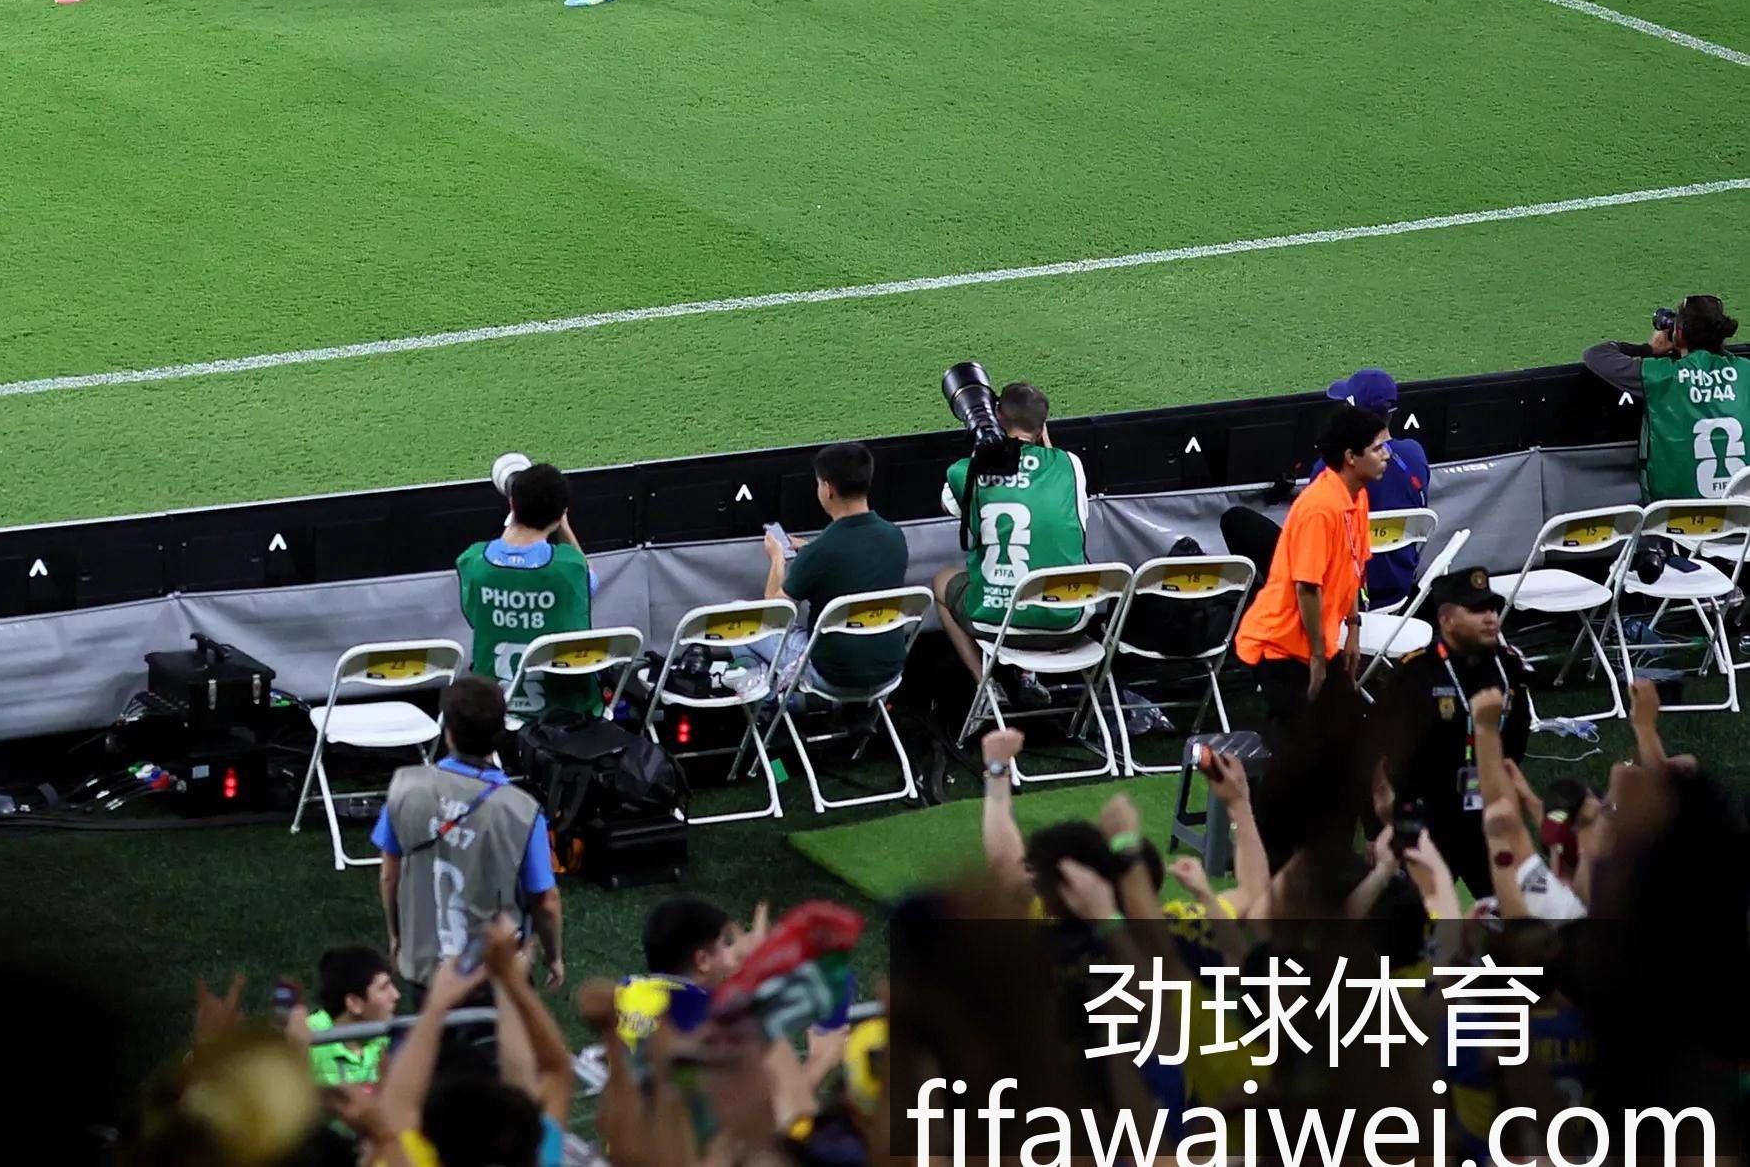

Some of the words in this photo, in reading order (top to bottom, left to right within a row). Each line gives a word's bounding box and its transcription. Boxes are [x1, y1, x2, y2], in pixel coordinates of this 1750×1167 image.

[1677, 366, 1739, 388] PHOTO
[1689, 384, 1737, 405] 0744
[1373, 527, 1386, 538] 16
[994, 567, 1015, 579] FIFA
[480, 586, 556, 610] PHOTO
[1067, 582, 1082, 593] 19
[492, 609, 546, 630] 0618
